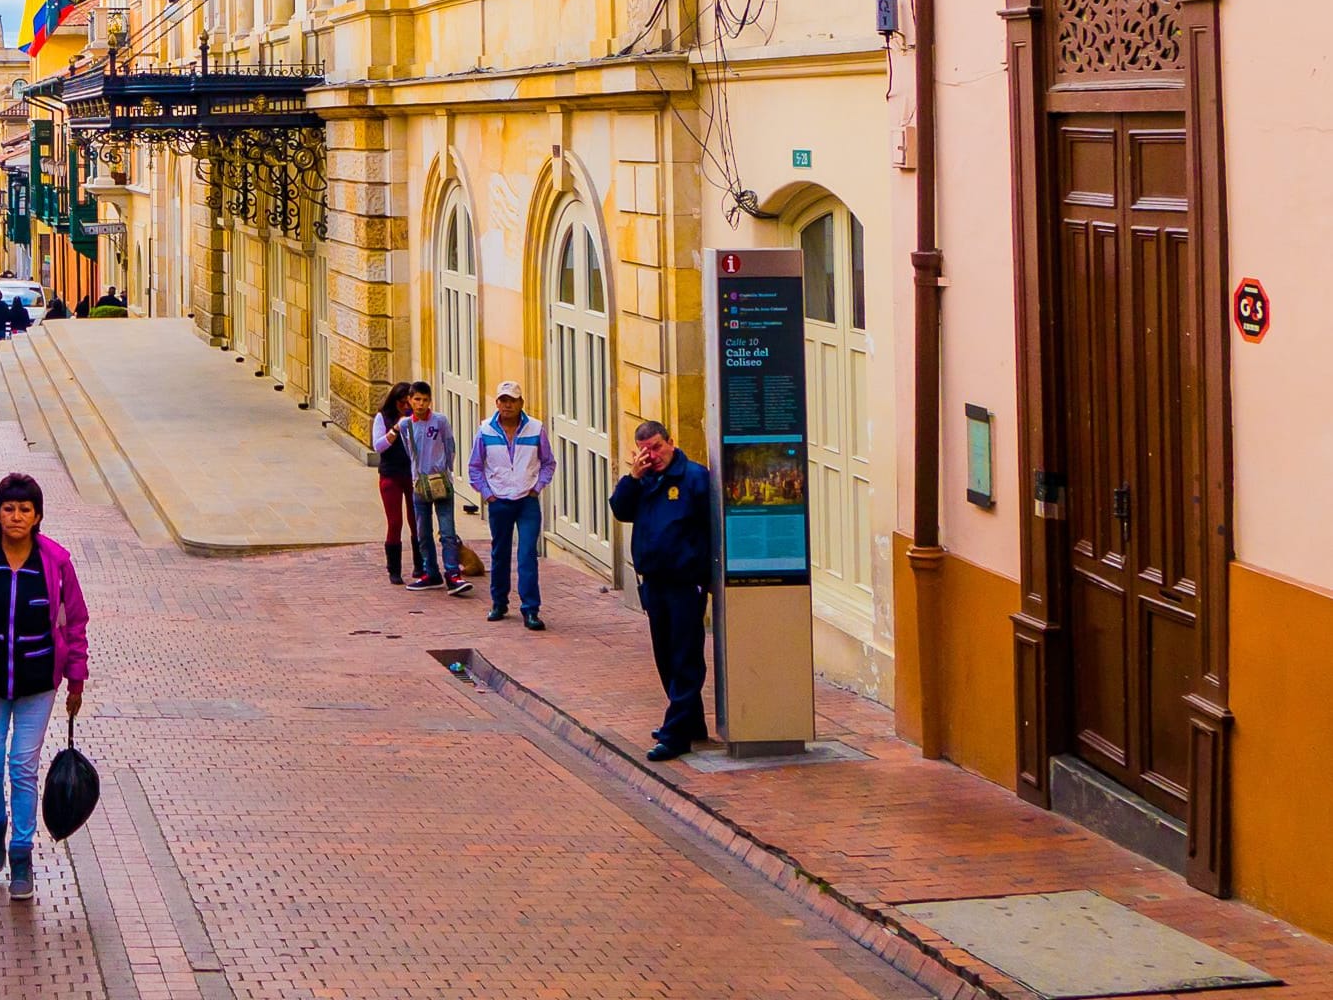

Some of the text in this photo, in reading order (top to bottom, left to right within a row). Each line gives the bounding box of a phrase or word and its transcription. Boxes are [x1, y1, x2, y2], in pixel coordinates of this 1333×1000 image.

[725, 338, 759, 346] Calle 10
[726, 347, 769, 357] Calle del
[726, 358, 762, 367] Coliseo
[426, 426, 439, 441] 87
